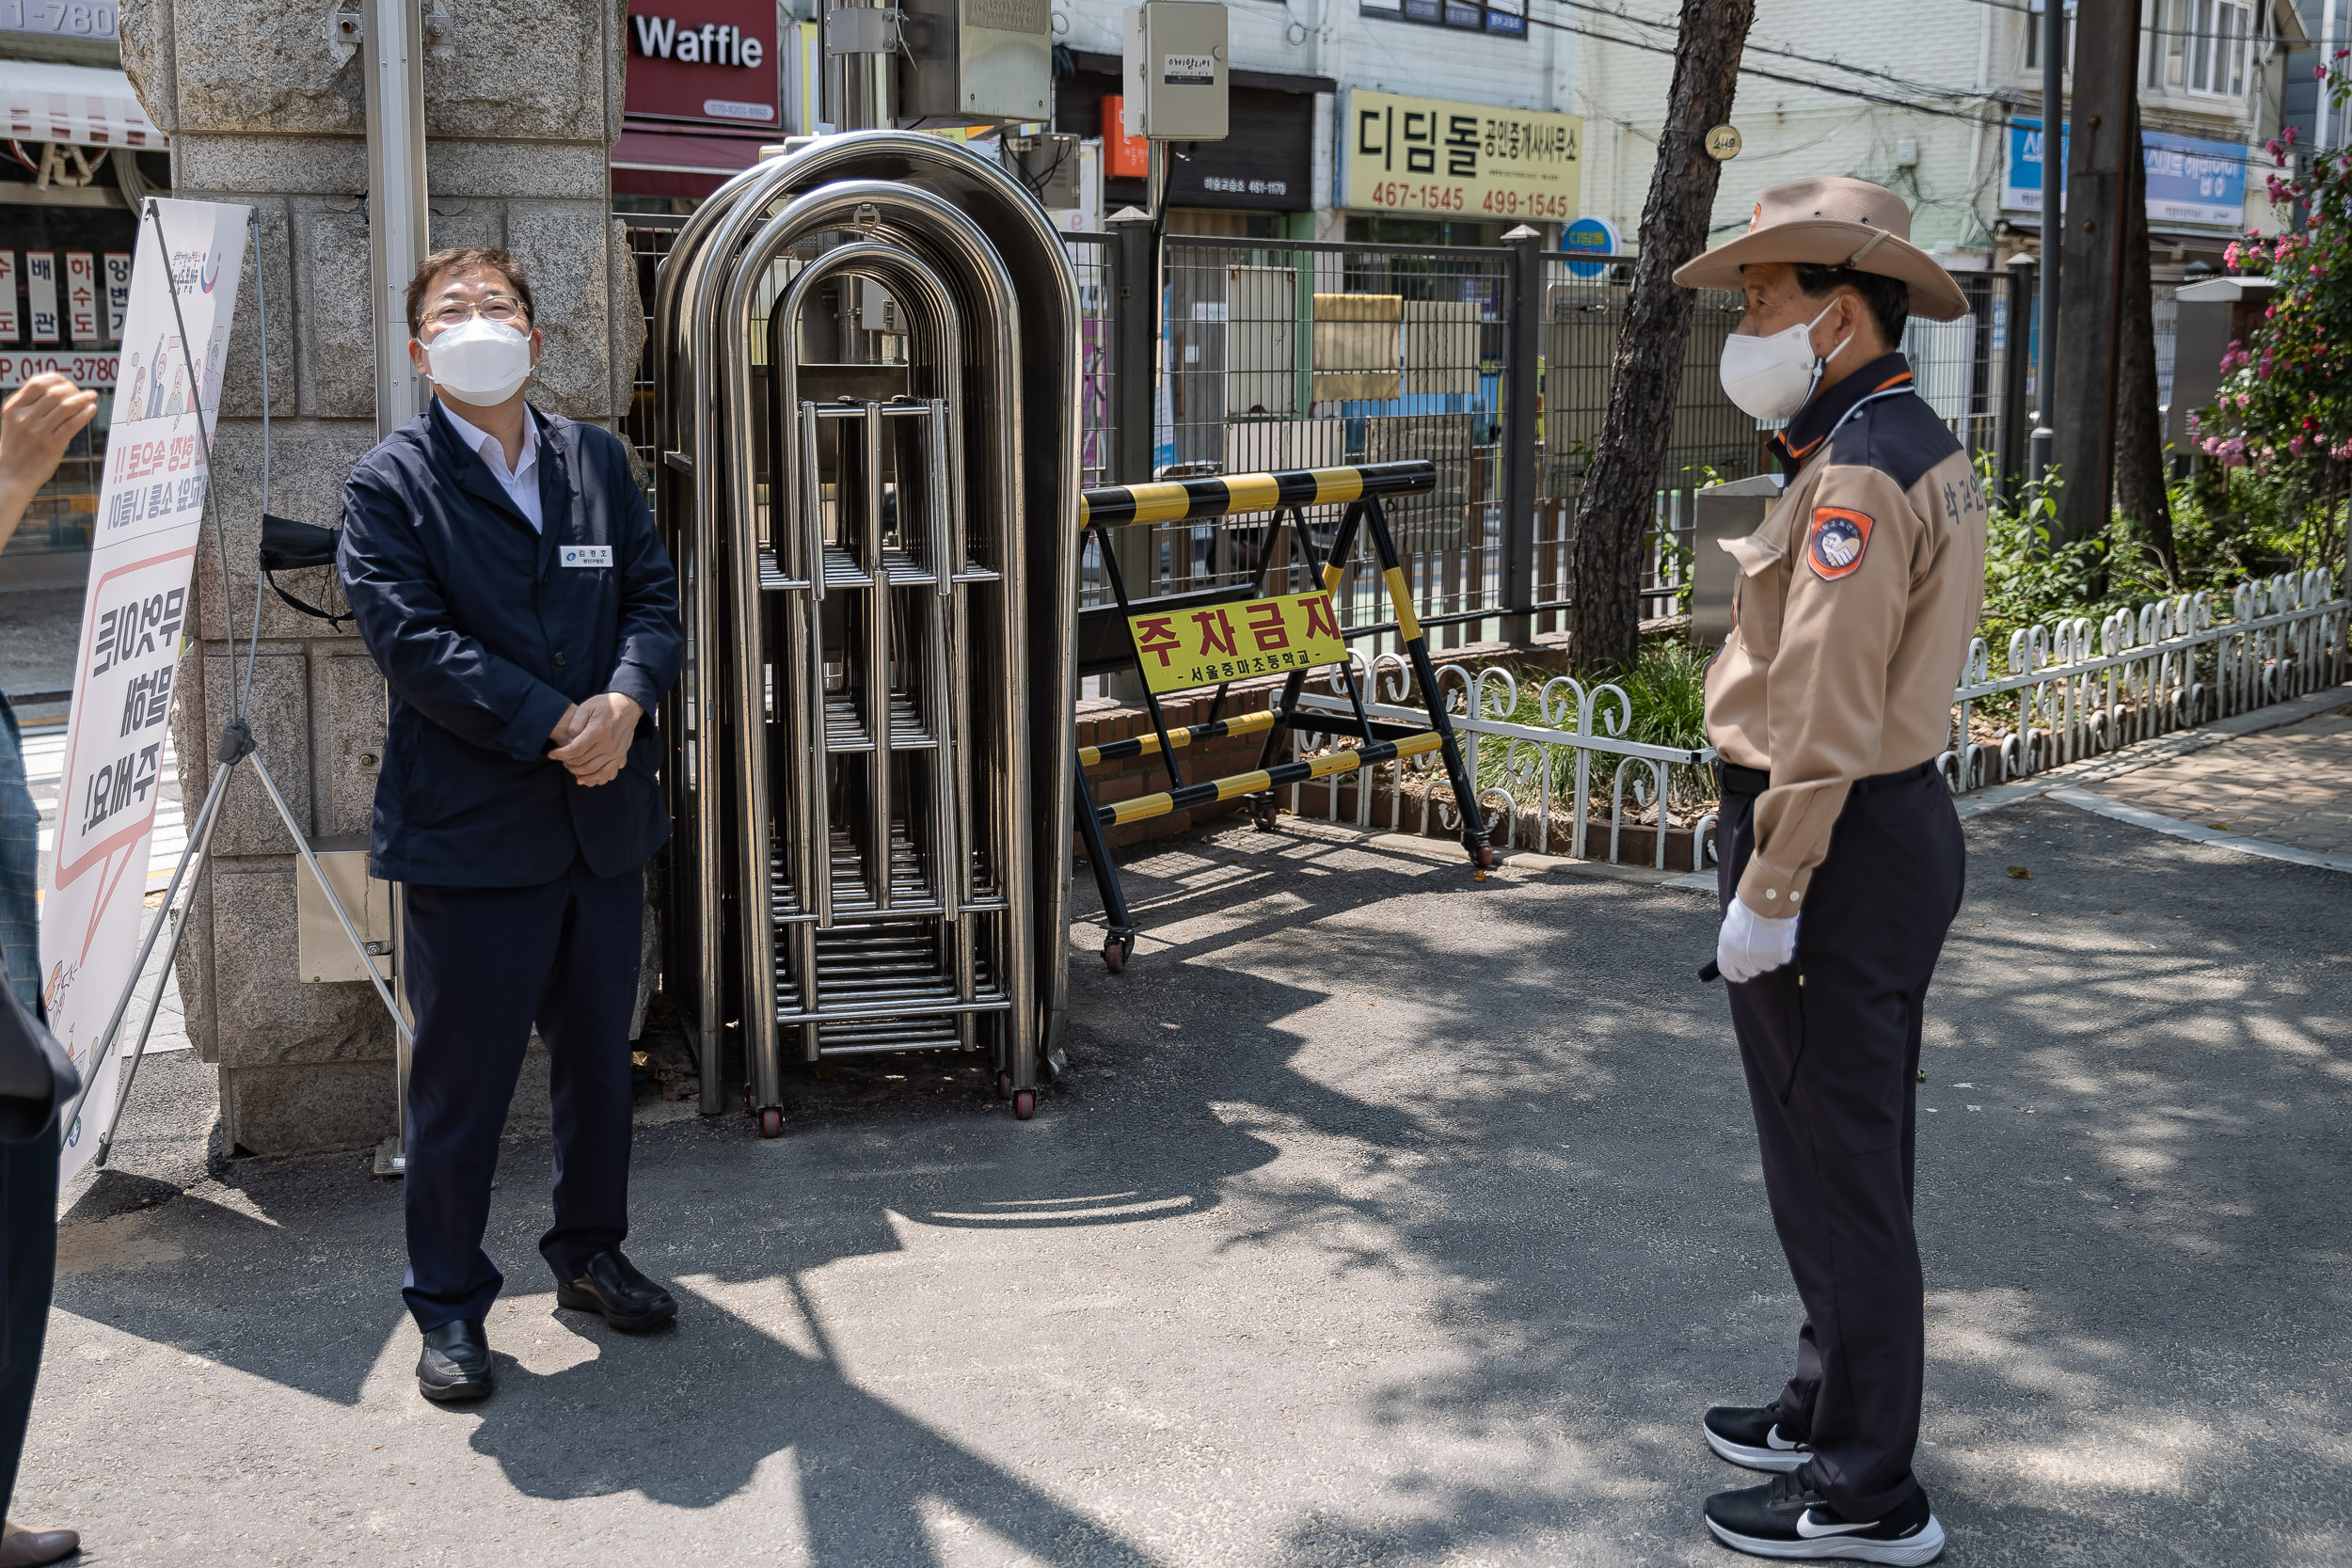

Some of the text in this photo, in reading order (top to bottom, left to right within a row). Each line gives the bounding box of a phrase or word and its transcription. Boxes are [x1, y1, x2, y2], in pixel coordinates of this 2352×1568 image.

[634, 14, 764, 69] Waffle
[1359, 105, 1481, 179] 디딤돌
[1372, 181, 1568, 218] 467-1545 499-1545
[31, 259, 56, 334] 배관
[70, 258, 94, 334] 하수도
[1136, 594, 1342, 667] 주차금지
[1190, 649, 1311, 683] 서울중마초등학교
